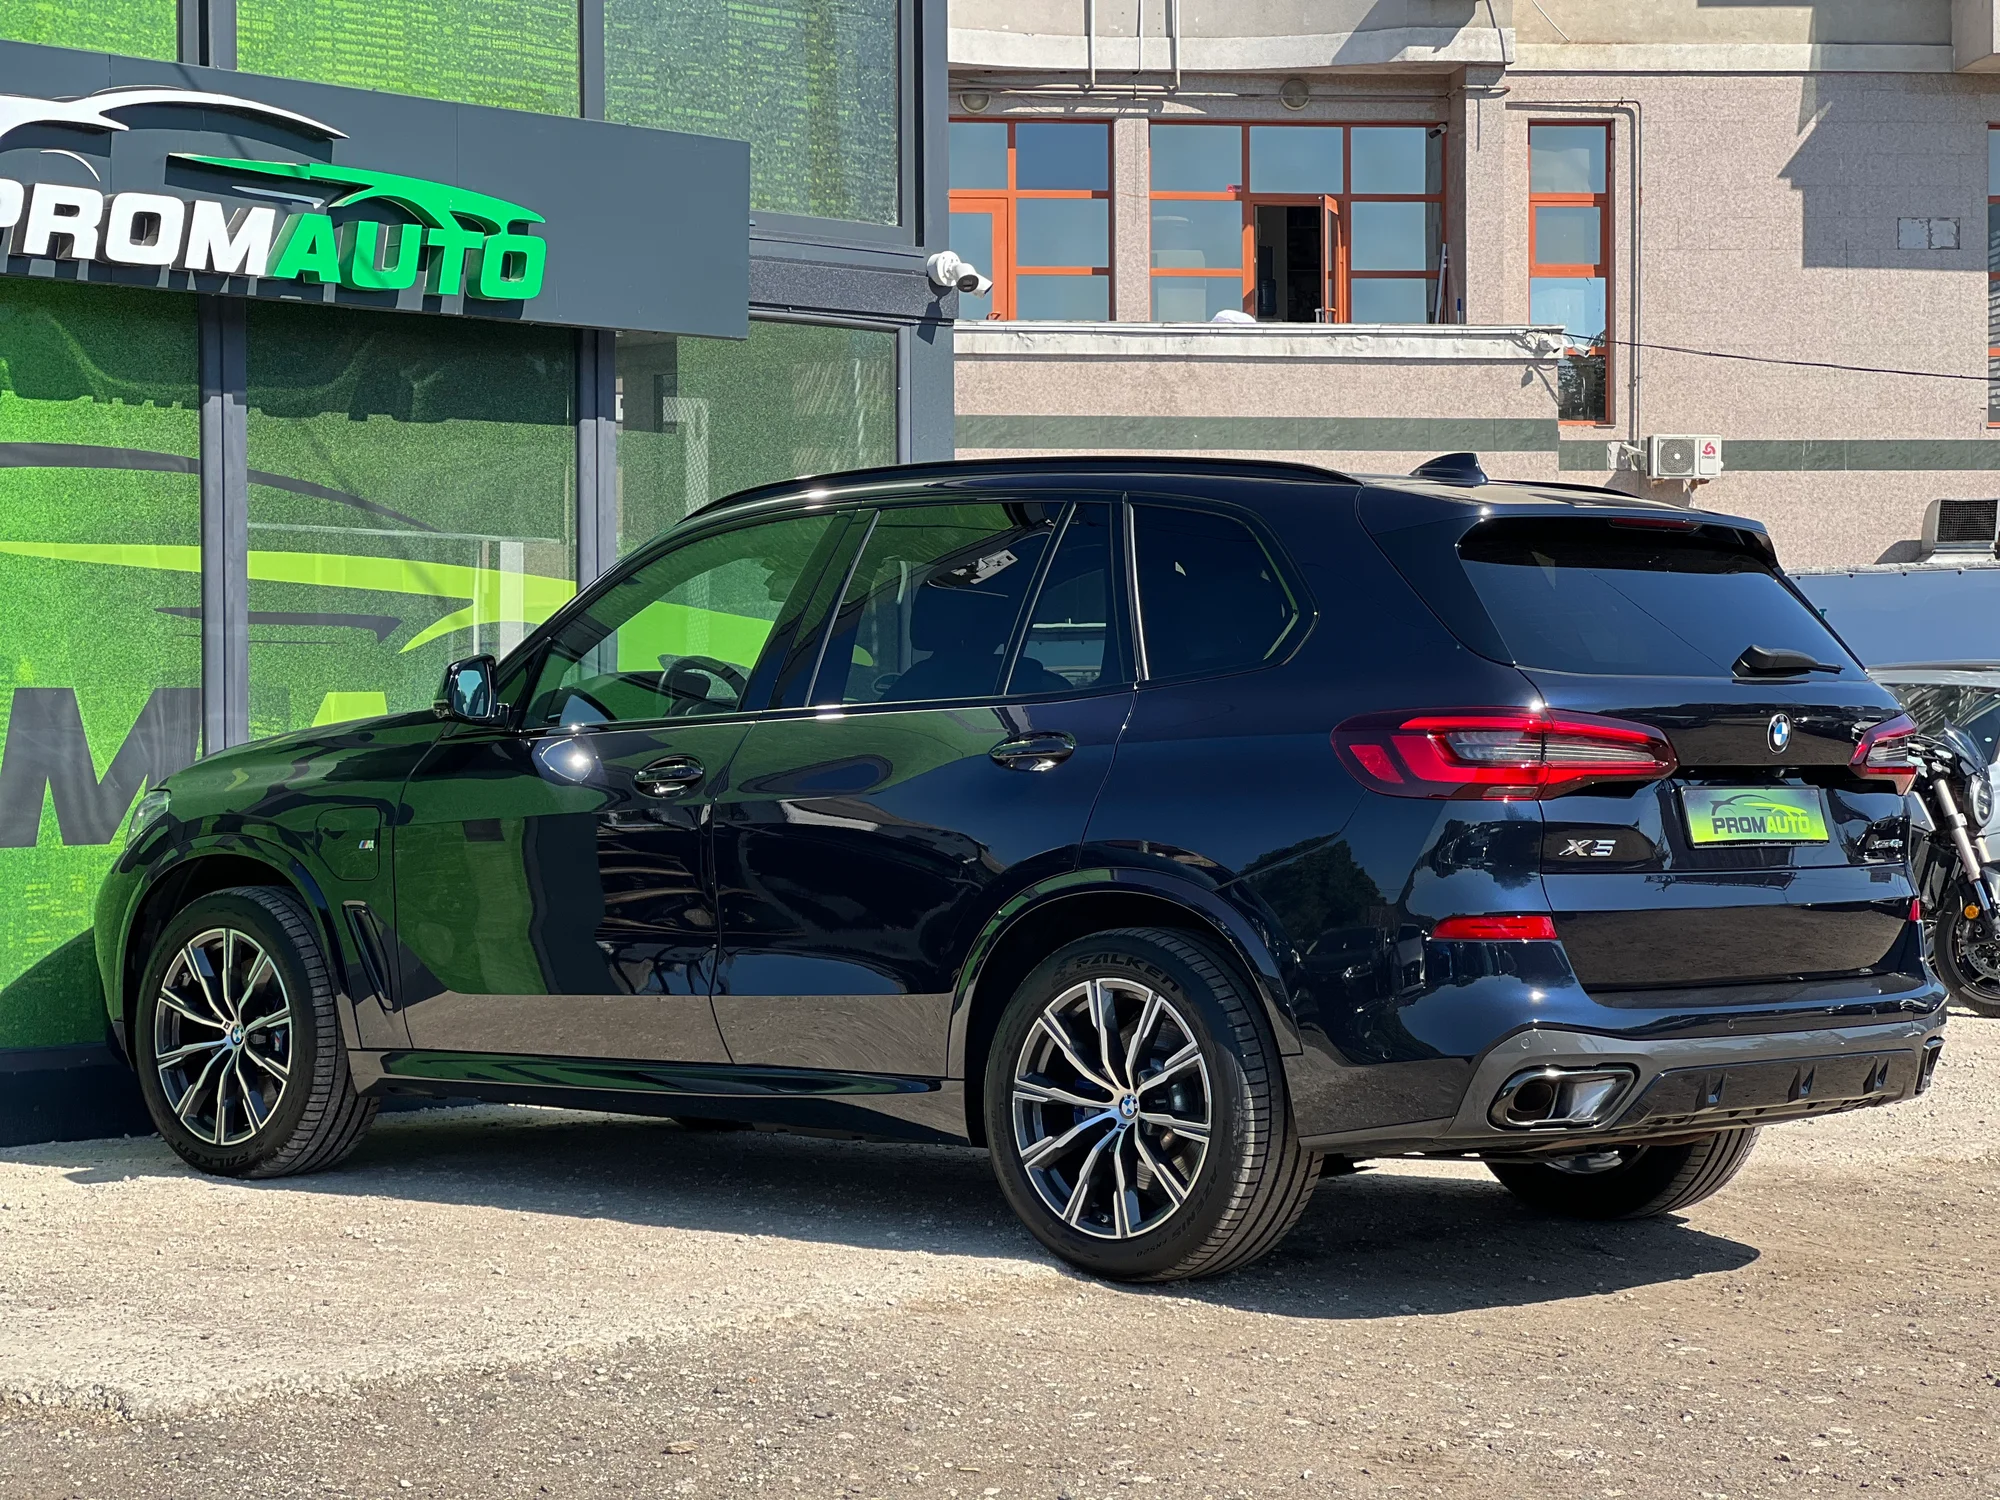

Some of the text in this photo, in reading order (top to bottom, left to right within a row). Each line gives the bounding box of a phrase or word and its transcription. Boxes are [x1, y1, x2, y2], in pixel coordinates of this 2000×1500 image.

[1711, 815, 1811, 835] PROMAUTO
[1558, 839, 1617, 857] X5
[1072, 952, 1181, 993] FALKEN
